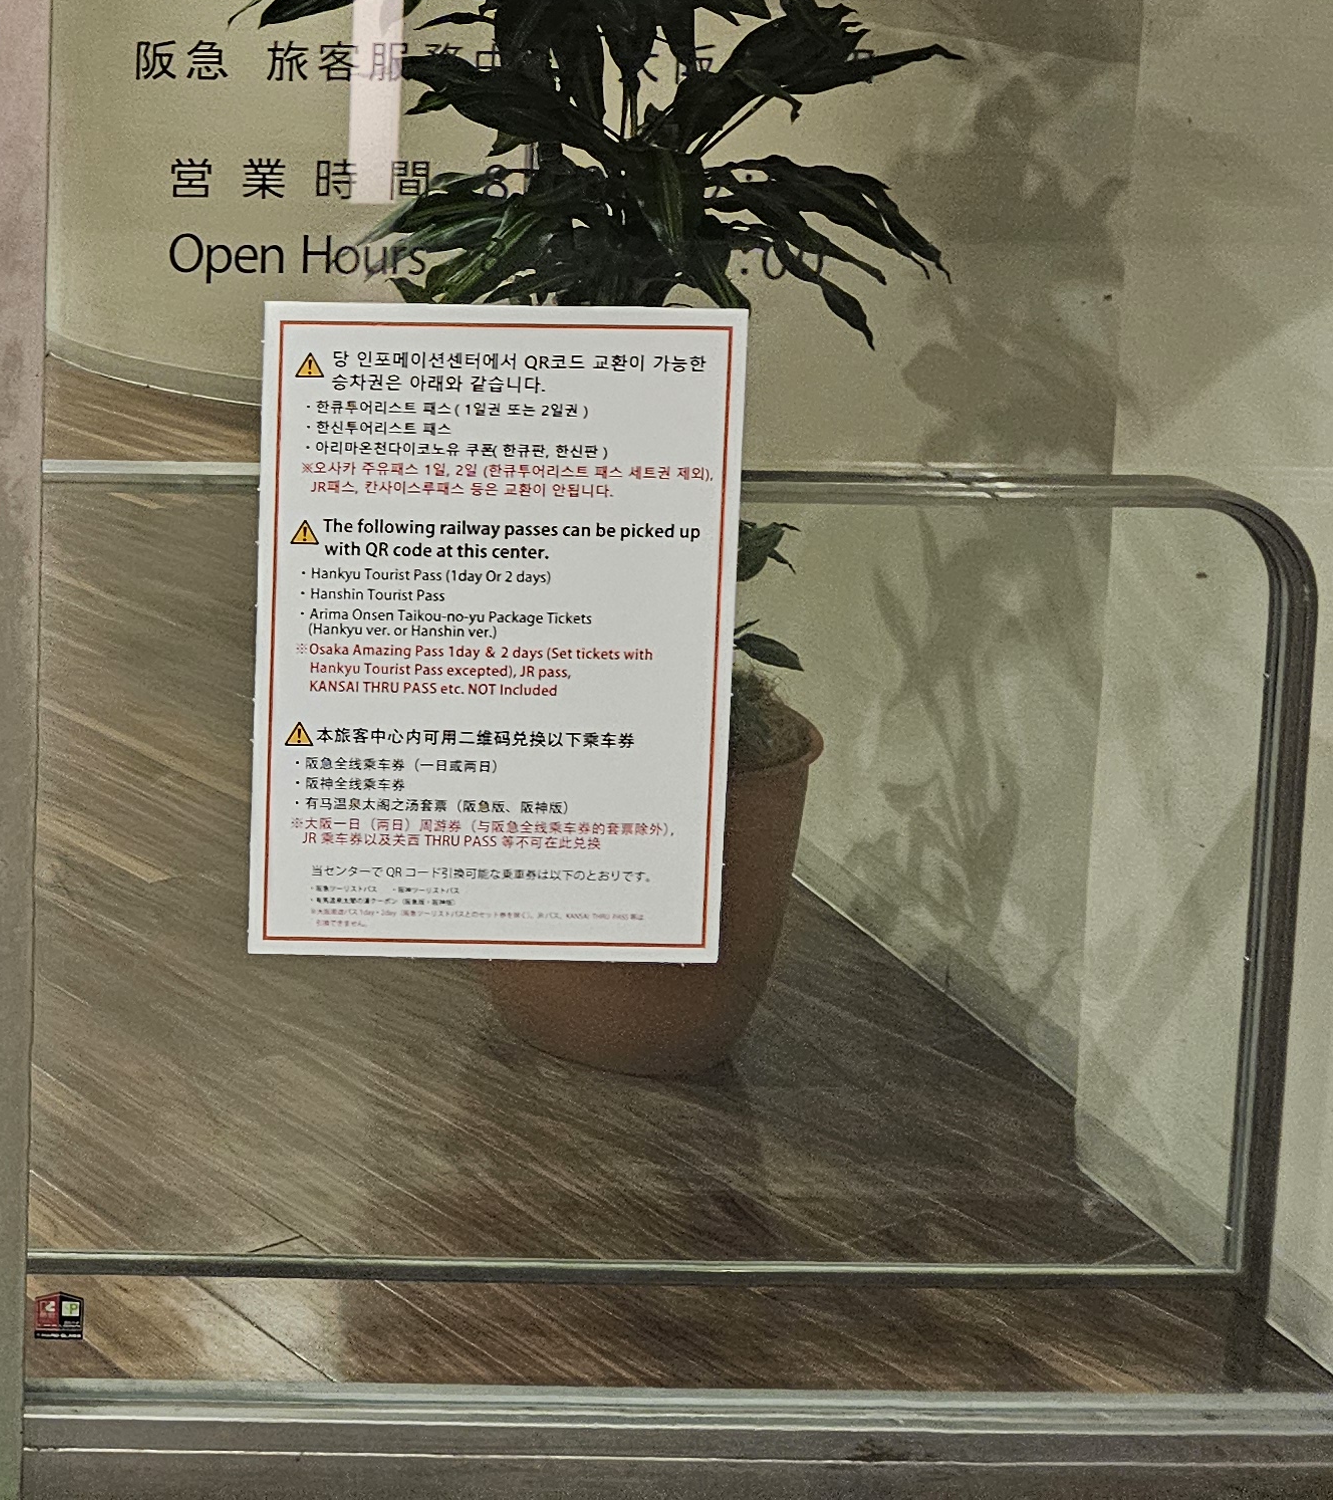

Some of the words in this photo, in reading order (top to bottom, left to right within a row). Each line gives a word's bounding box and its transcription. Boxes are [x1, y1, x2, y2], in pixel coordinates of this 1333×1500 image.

[135, 39, 229, 80] 阪急
[169, 233, 284, 283] Open
[302, 235, 426, 275] Hours
[334, 351, 349, 367] 당
[358, 351, 516, 370] 인포메이션센터에서
[525, 355, 585, 370] QR코드
[593, 355, 644, 371] 교환이
[654, 355, 706, 372] 가능한
[332, 374, 401, 391] 승차권은
[410, 375, 463, 392] 아래와
[471, 376, 545, 394] 같습니다.
[317, 401, 416, 414] 한큐투어리스트
[466, 403, 500, 416] 1일권
[507, 404, 535, 416] 또는
[317, 421, 416, 435] 한신투어리스트
[423, 423, 451, 436] 패스
[316, 441, 460, 456] 아리마온천다이코노유
[503, 444, 548, 458] 한큐판,
[362, 462, 418, 476] 주유패스
[425, 463, 449, 477] 1일,
[456, 464, 476, 477] 2일
[484, 464, 589, 478] (한큐투어리스트
[594, 466, 622, 479] 패스
[629, 466, 670, 480] 세트권
[677, 467, 713, 481] 제외),
[311, 480, 358, 494] JR패스,
[365, 481, 464, 495] 칸사이스루패스
[471, 483, 498, 496] 등은
[504, 483, 545, 497] 교환이
[553, 484, 613, 498] 안됩니다.
[323, 518, 353, 532] The
[358, 518, 435, 538] following
[440, 520, 500, 539] railway
[505, 525, 558, 539] passes
[563, 526, 590, 537] can
[596, 522, 616, 537] be
[621, 523, 674, 541] picked
[680, 528, 700, 542] up
[325, 542, 360, 555] with
[366, 542, 388, 557] QR
[393, 543, 432, 557] code
[436, 545, 453, 557] at
[457, 543, 487, 558] this
[492, 546, 549, 559] center.
[312, 567, 360, 582] Hankyu
[365, 568, 410, 580] Tourist
[414, 569, 442, 581] Pass
[446, 570, 482, 584] (1day
[486, 570, 501, 582] Or
[505, 571, 512, 582] 2
[517, 571, 551, 585] days)
[311, 588, 363, 600] Hanshin
[367, 588, 413, 601] Tourist
[417, 589, 445, 601] Pass
[310, 608, 348, 621] Arima
[352, 609, 393, 621] Onsen
[398, 609, 484, 628] Taikou-no-yu
[489, 611, 543, 628] Package
[547, 612, 591, 624] Tickets
[309, 623, 362, 638] (Hankyu
[366, 627, 390, 636] ver.
[394, 627, 407, 636] or
[412, 625, 464, 637] Hanshin
[468, 624, 497, 639] ver.)
[353, 644, 411, 659] Amazing
[416, 645, 444, 657] Pass
[449, 646, 480, 660] 1day
[485, 646, 495, 658] &
[501, 647, 508, 658] 2
[513, 647, 543, 661] days
[547, 647, 572, 660] (Set
[576, 648, 620, 660] tickets
[624, 649, 652, 660] with
[311, 662, 360, 677] Hankyu
[364, 663, 410, 675] Tourist
[415, 664, 443, 675] Pass
[447, 665, 516, 679] excepted),
[520, 666, 534, 677] JR
[539, 669, 571, 680] pass,
[310, 681, 359, 692] KANSAI
[363, 682, 399, 693] THRU
[404, 682, 437, 694] PASS
[441, 685, 464, 694] etc.
[468, 684, 496, 695] NOT
[500, 684, 557, 696] Included
[317, 727, 634, 748] 本旅客中心内可用二维码兑换以下乘车券
[306, 777, 404, 791] 阪神全线乘车券
[302, 832, 316, 843] JR
[424, 834, 460, 846] THRU
[464, 835, 497, 847] PASS
[386, 867, 402, 878] QR
